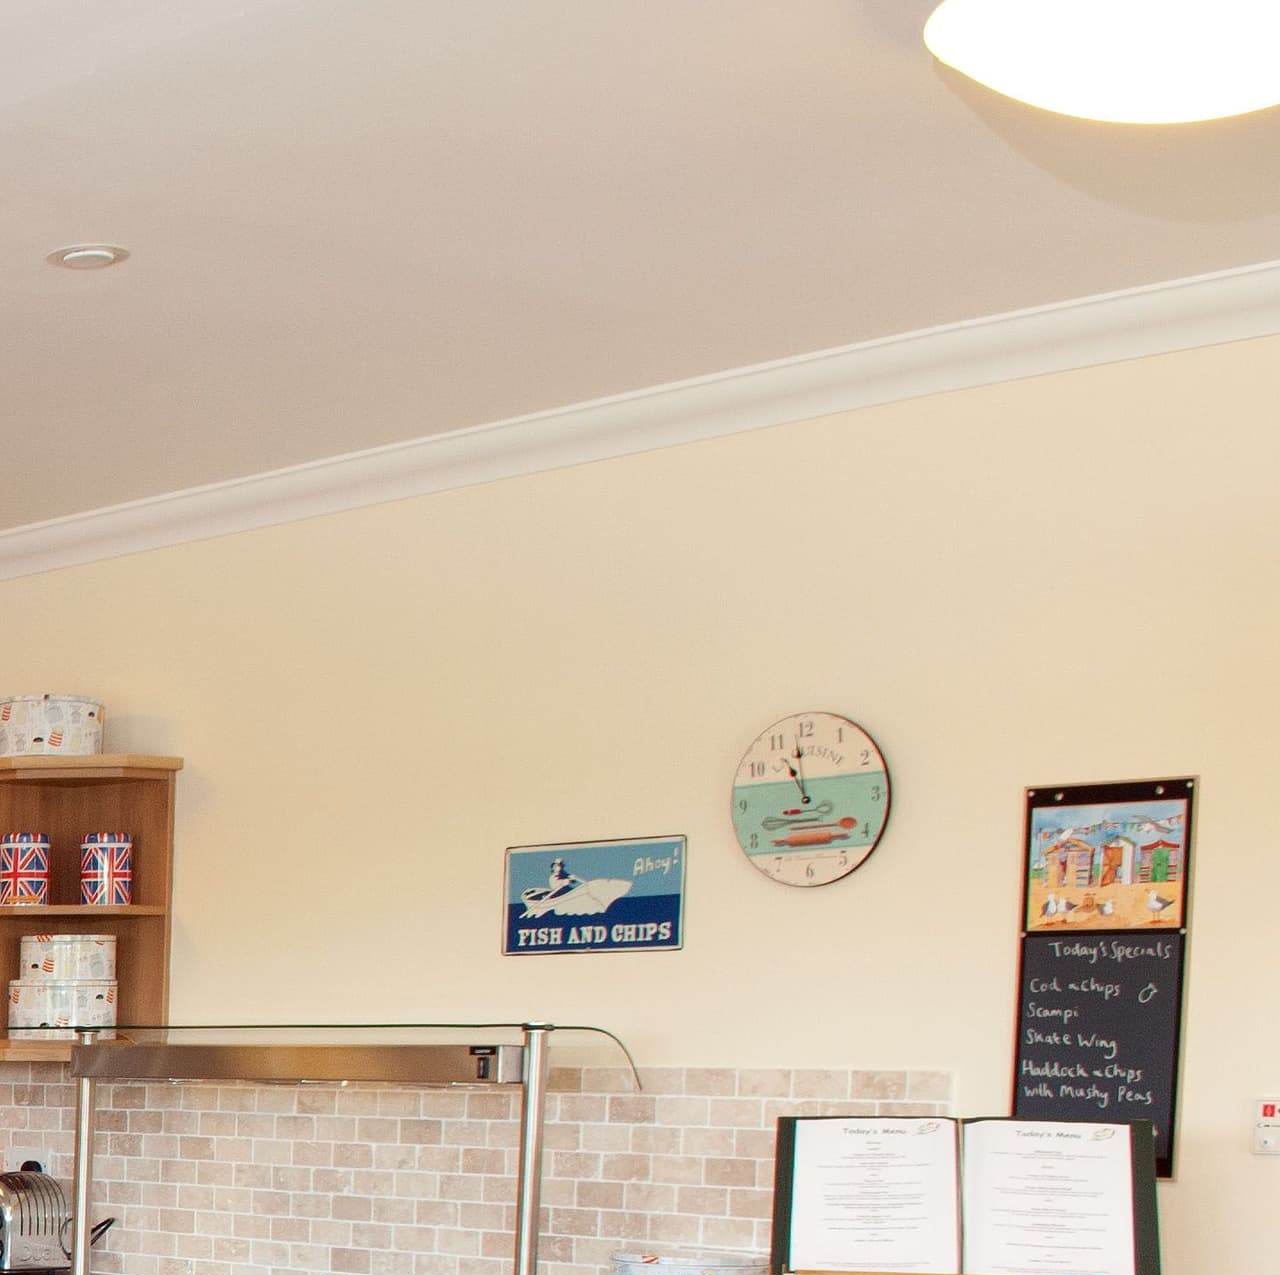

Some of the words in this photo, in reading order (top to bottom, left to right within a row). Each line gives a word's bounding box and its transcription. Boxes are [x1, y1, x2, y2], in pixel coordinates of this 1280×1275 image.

[798, 721, 814, 737] 12
[769, 734, 784, 750] 11
[860, 750, 870, 766] 2
[750, 762, 765, 778] 10
[871, 786, 881, 801] 3
[739, 800, 748, 815] 9
[861, 822, 870, 838] 4
[750, 833, 759, 848] 8
[633, 847, 680, 876] Ahoy!
[806, 863, 814, 878] 6
[518, 927, 563, 947] FISH
[567, 925, 608, 945] AND
[611, 921, 672, 943] CHIPS
[1048, 941, 1107, 964] Today's
[1109, 941, 1172, 963] Specials
[1030, 977, 1062, 993] Cod
[1081, 977, 1121, 1000] Chips
[1026, 1002, 1079, 1025] Scampi
[1025, 1028, 1072, 1045] Skate
[1077, 1033, 1118, 1060] Wing
[1021, 1059, 1089, 1078] Haddock
[1104, 1064, 1144, 1083] Chips
[1023, 1083, 1054, 1098] with
[1059, 1084, 1110, 1109] Mushy
[1117, 1086, 1153, 1105] Peas
[842, 1127, 878, 1136] Today's
[1015, 1129, 1052, 1139] Today's
